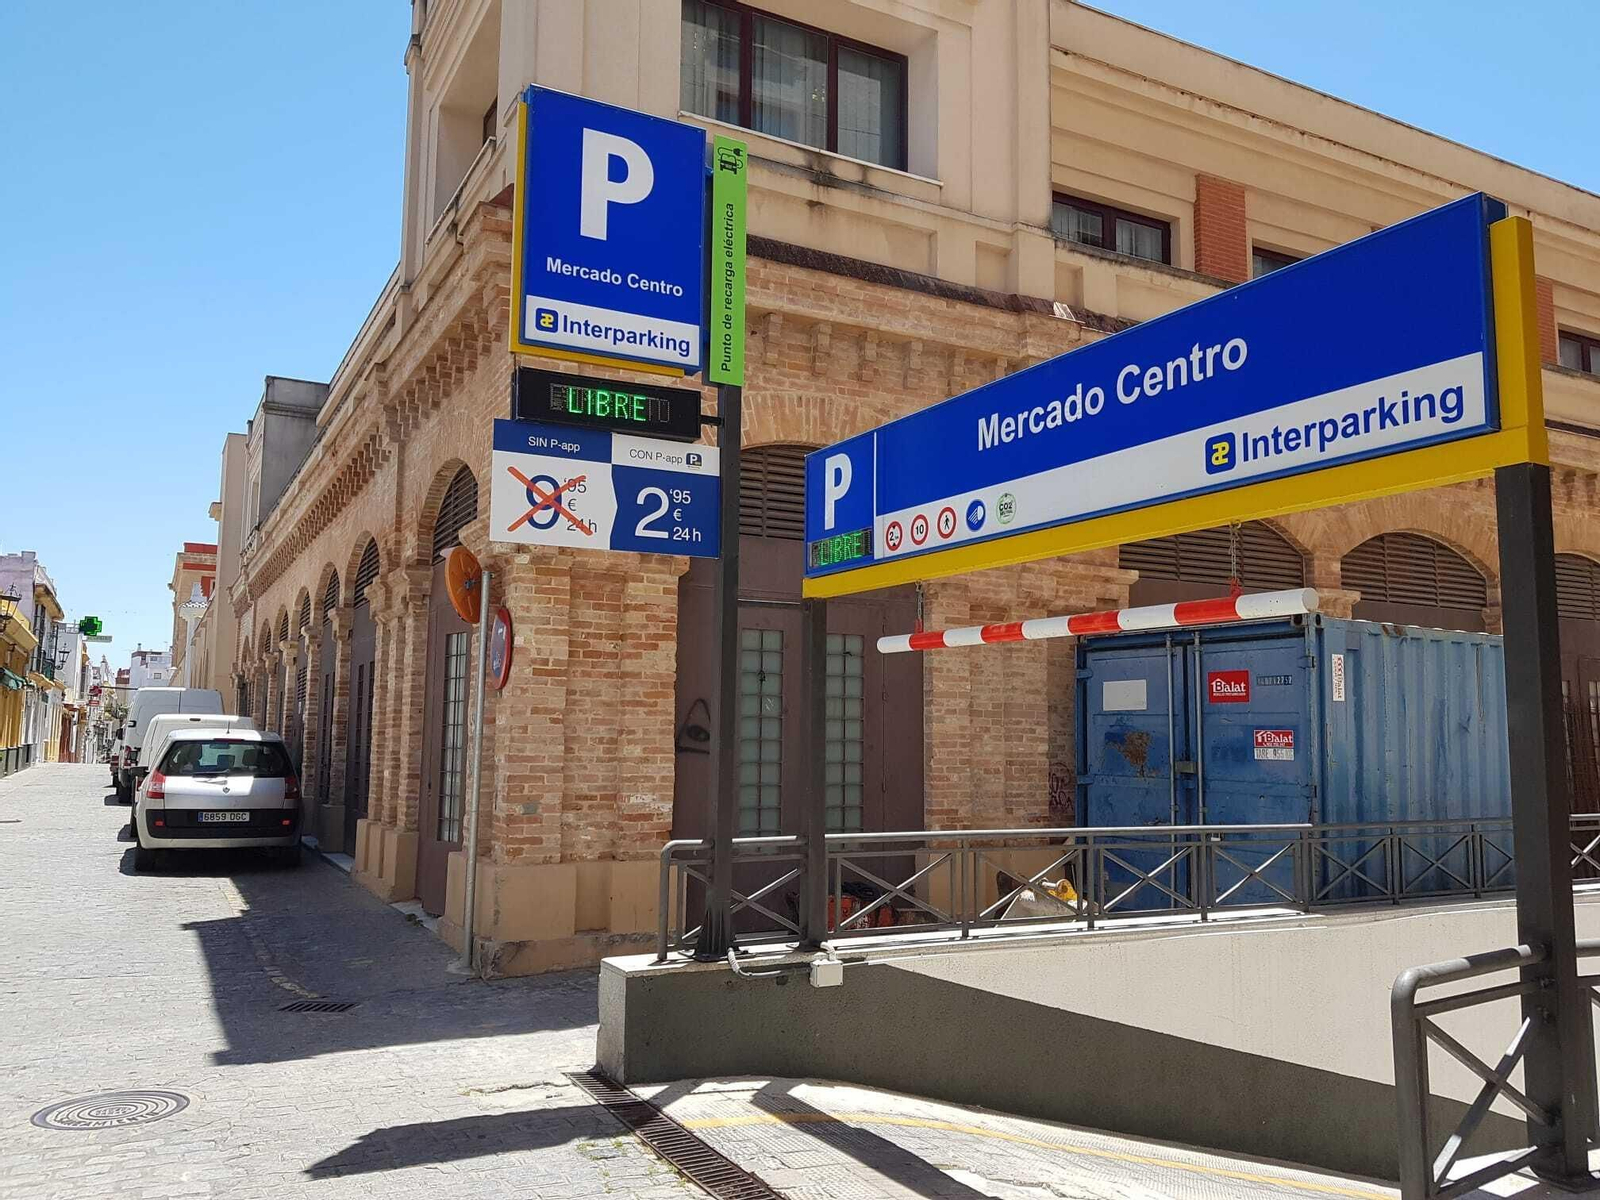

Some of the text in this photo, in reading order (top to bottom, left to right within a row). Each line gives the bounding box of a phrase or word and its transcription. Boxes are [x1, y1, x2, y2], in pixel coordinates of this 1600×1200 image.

[580, 127, 655, 241] P
[546, 256, 684, 297] Mercado Centro
[721, 203, 736, 372] Punto de recarga eléctrica
[563, 314, 691, 357] Interparking
[568, 387, 648, 422] LIBRE
[977, 336, 1249, 452] Mercado Centro
[1242, 384, 1465, 463] Interparking
[527, 436, 581, 453] SIN P-app
[629, 448, 654, 460] CON
[655, 450, 683, 464] P-app
[526, 474, 562, 530] 9
[568, 498, 577, 512] €
[824, 452, 853, 530] P
[634, 486, 670, 539] 2
[673, 508, 682, 522] €
[915, 524, 924, 535] 10
[820, 532, 863, 566] LIBRE
[1213, 679, 1246, 693] Balat
[1264, 733, 1293, 743] Balat
[204, 812, 227, 821] 6859
